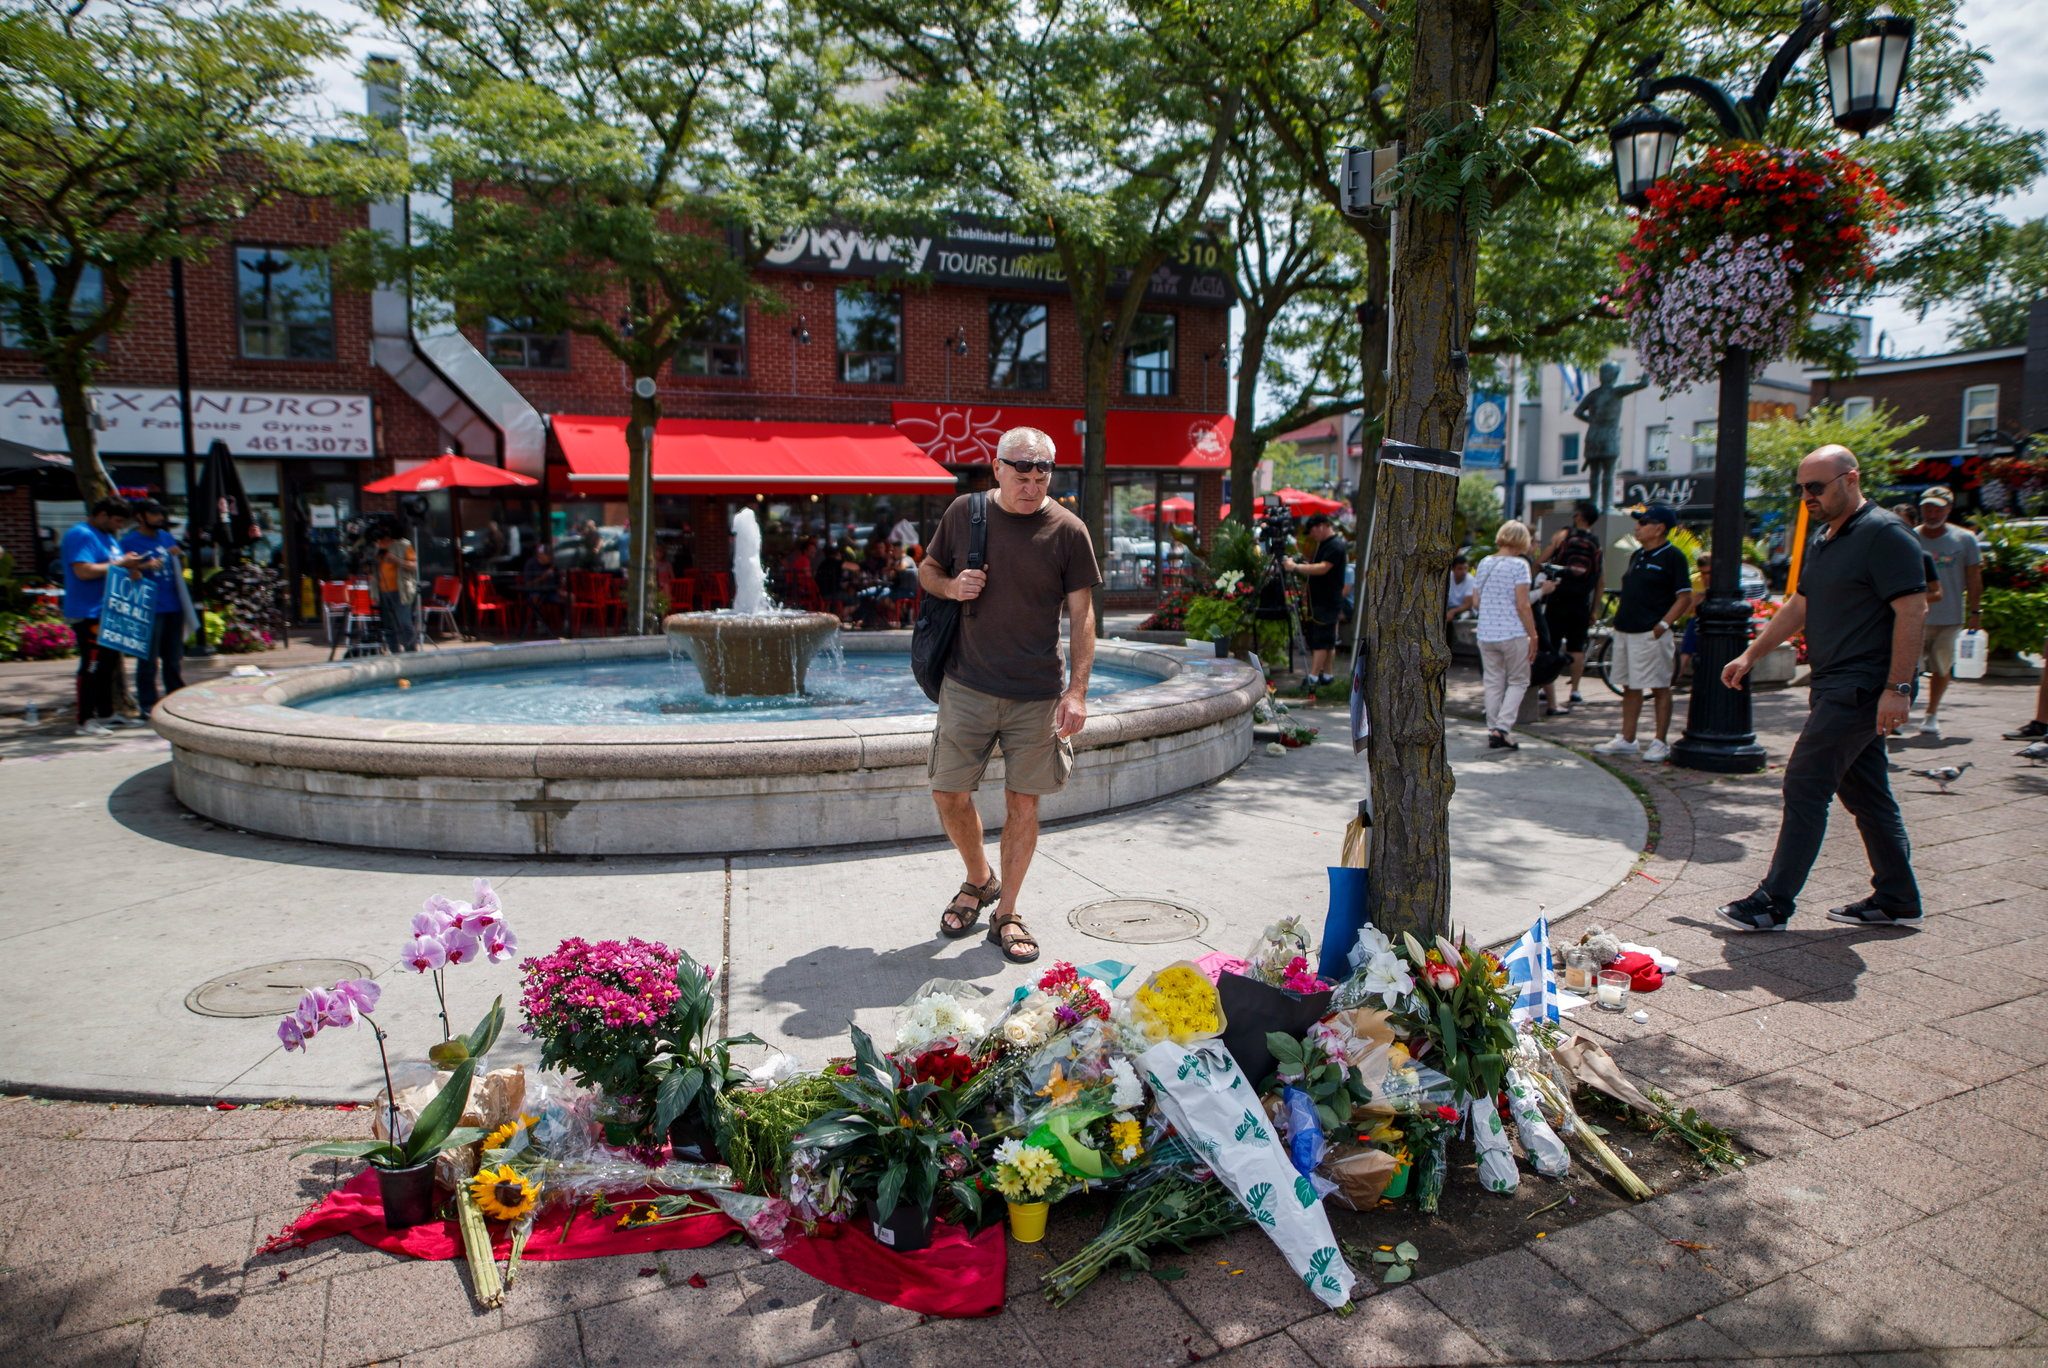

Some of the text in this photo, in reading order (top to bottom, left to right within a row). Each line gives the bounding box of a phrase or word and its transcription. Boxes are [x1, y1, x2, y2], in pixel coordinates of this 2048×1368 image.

[1008, 232, 1037, 246] Since
[938, 251, 998, 276] TOURS
[3, 388, 365, 418] AXANDROS
[262, 420, 333, 433] Gyros
[246, 436, 369, 452] 461-3073
[111, 573, 155, 610] LOVE
[108, 597, 151, 624] FOR ALL
[102, 629, 148, 654] FOR NONE
